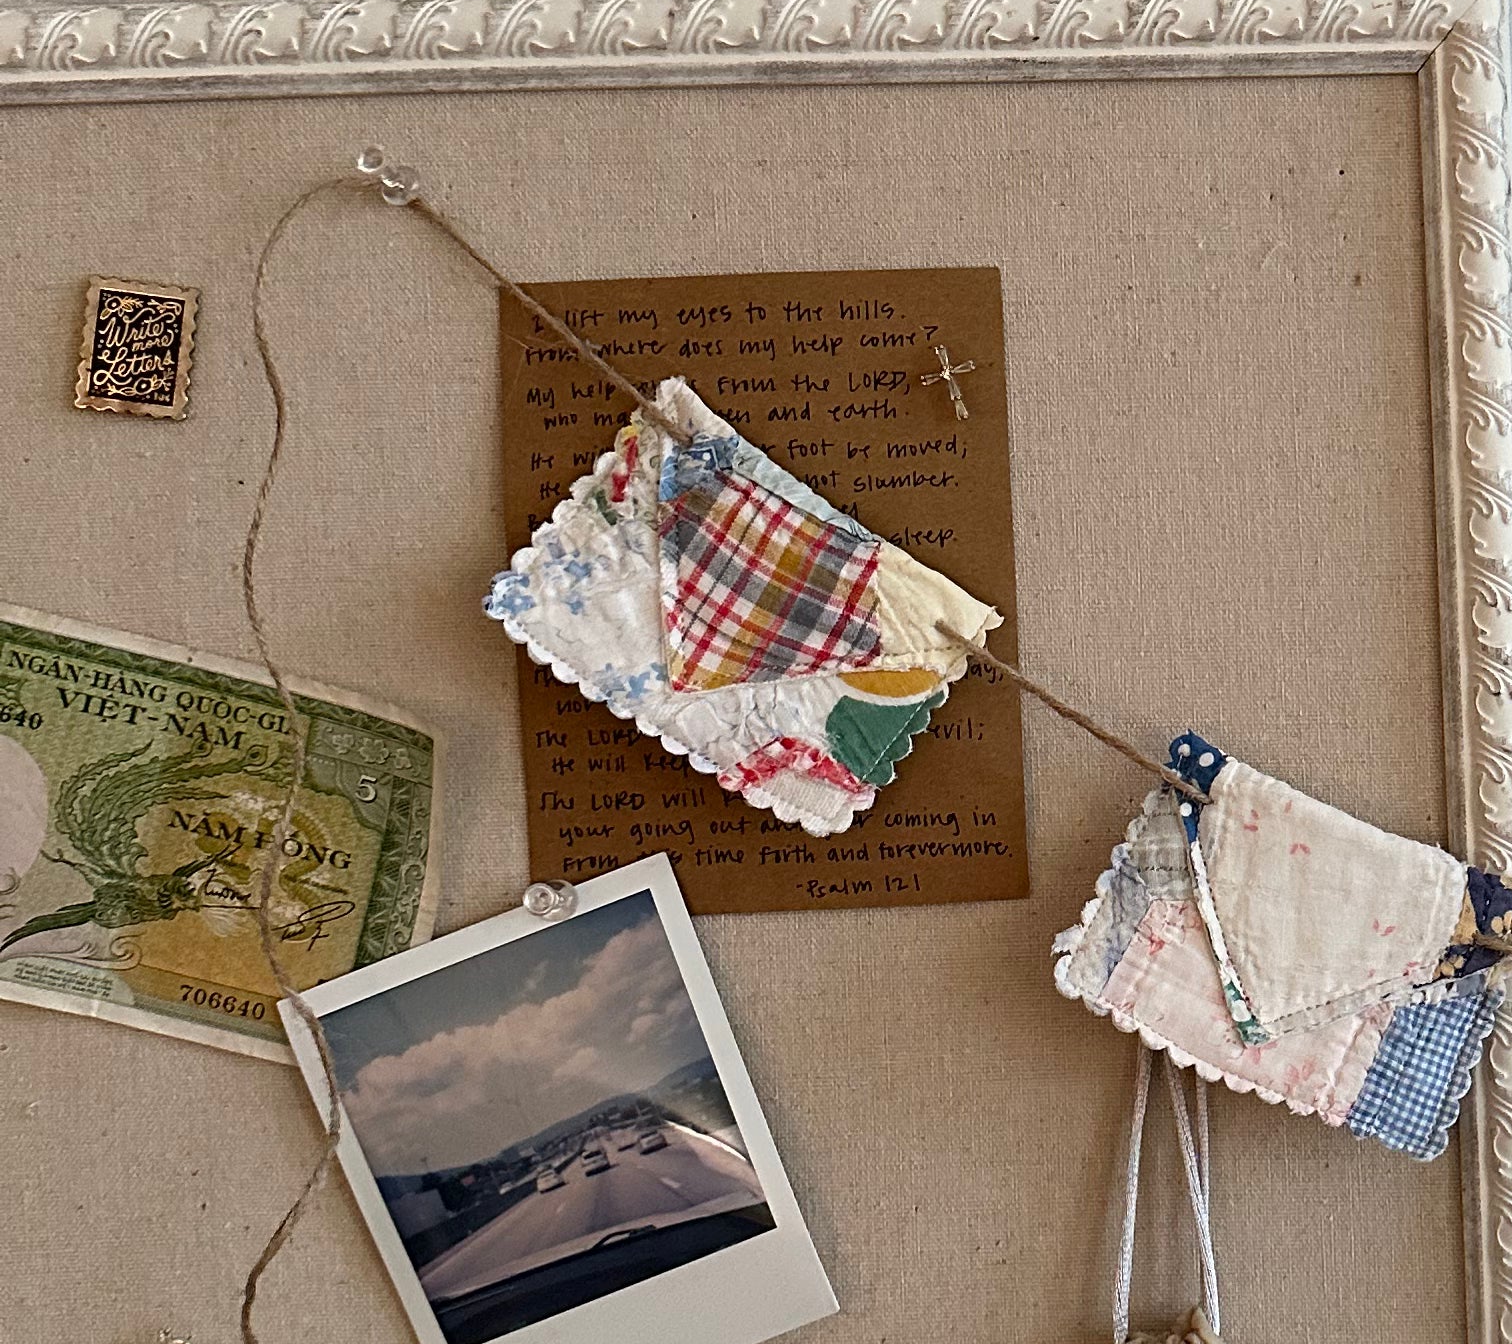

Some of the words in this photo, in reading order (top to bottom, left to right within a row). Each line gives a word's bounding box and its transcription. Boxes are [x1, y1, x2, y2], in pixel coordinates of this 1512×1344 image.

[98, 308, 176, 347] Write
[564, 309, 604, 328] lift
[618, 308, 657, 330] my
[676, 304, 732, 330] eyes
[745, 301, 767, 325] to
[783, 300, 823, 323] the
[840, 299, 907, 322] hills.
[679, 339, 723, 358] does
[739, 338, 776, 361] my
[792, 335, 844, 356] help
[859, 325, 939, 351] come?
[527, 387, 555, 409] My
[571, 380, 617, 401] help
[790, 373, 830, 393] the
[849, 370, 911, 395] LORD,
[543, 412, 578, 431] who
[767, 401, 811, 422] and
[828, 399, 910, 422] earth.
[847, 442, 870, 459] be
[887, 434, 967, 459] moved;
[964, 662, 1003, 684] ay,
[536, 731, 567, 748] The
[552, 757, 575, 775] He
[588, 755, 626, 772] will
[355, 775, 379, 804] 5
[540, 791, 575, 811] The
[592, 790, 646, 811] LORD
[662, 788, 706, 808] will
[559, 824, 615, 847] your
[630, 819, 695, 846] going
[710, 816, 751, 835] out
[884, 807, 960, 837] coming
[973, 806, 997, 827] in
[695, 844, 745, 867] time
[827, 843, 870, 863] and
[878, 839, 1013, 861] forevermore.
[884, 873, 921, 892] 121
[179, 984, 267, 1022] 706640
